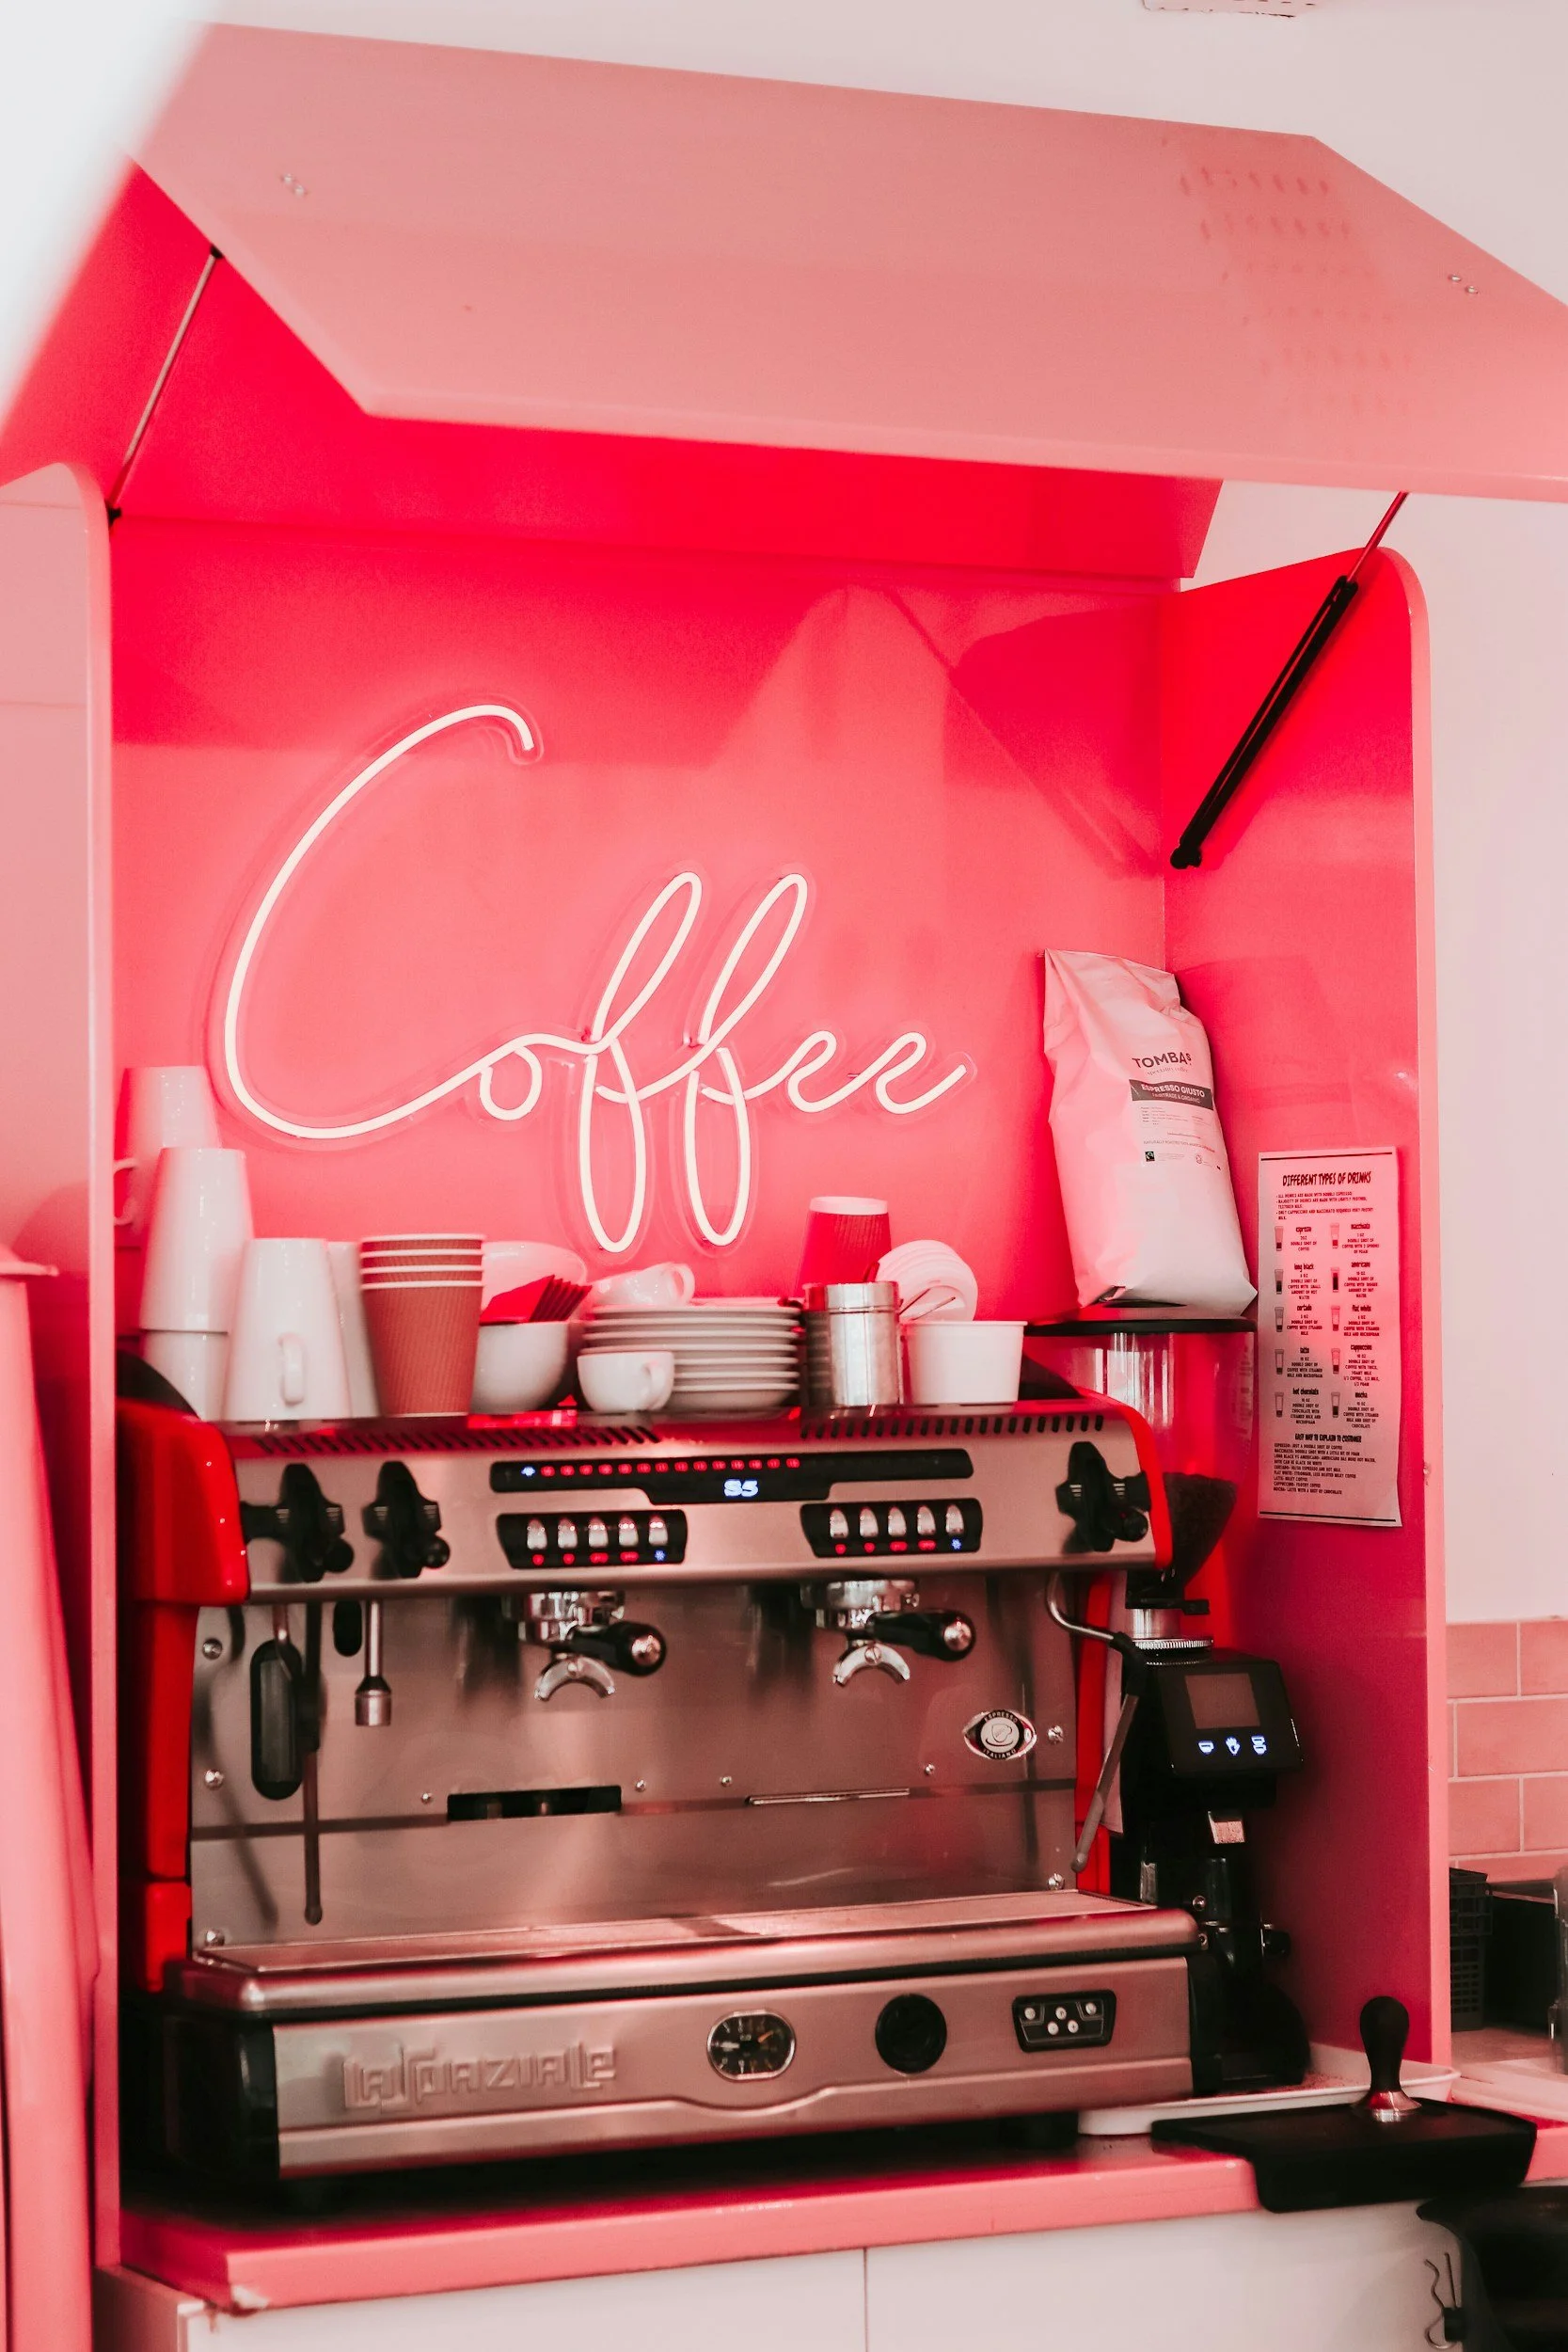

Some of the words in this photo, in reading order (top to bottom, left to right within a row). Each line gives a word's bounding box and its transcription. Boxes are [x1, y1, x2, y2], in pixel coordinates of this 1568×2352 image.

[225, 705, 967, 1252] Coffee
[1141, 1084, 1180, 1093] ESPRESSO
[1180, 1088, 1205, 1098] GIUSTO
[1282, 1174, 1317, 1186] DIFFERENT
[1318, 1172, 1336, 1185] TYPES
[1338, 1172, 1346, 1184] OF
[1347, 1170, 1371, 1184] DRINKS
[984, 1711, 1018, 1724] ESPRESSO
[983, 1749, 1016, 1759] ITALIANO
